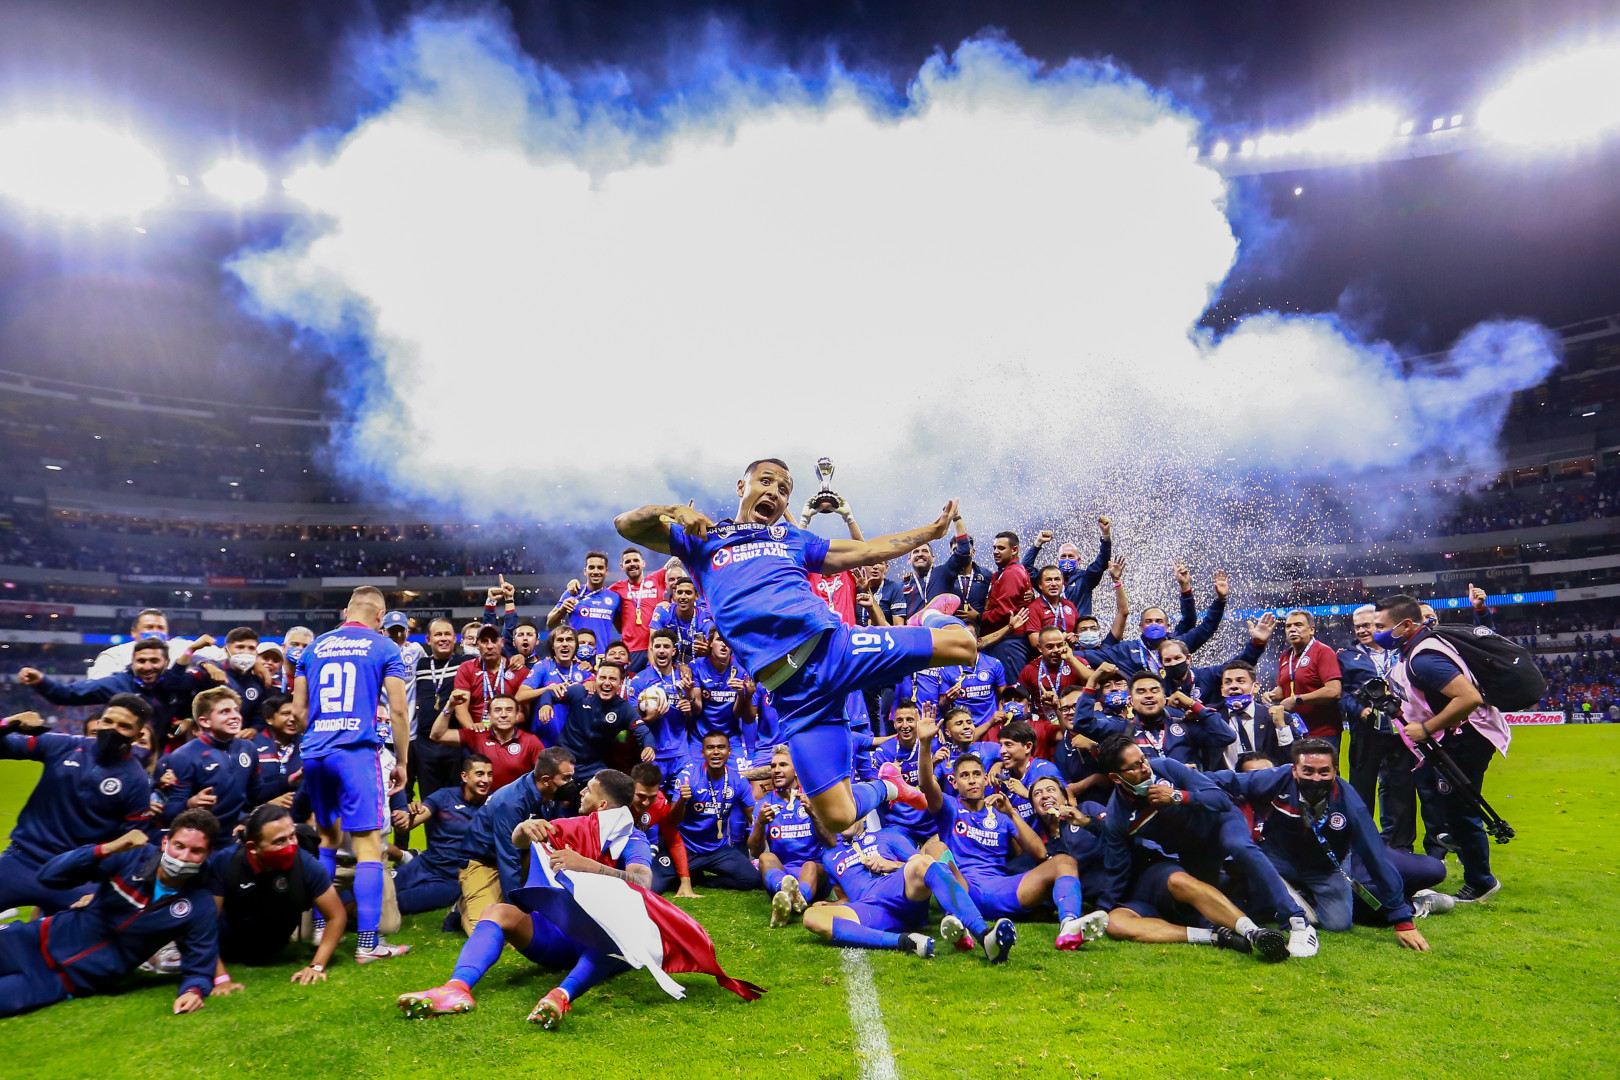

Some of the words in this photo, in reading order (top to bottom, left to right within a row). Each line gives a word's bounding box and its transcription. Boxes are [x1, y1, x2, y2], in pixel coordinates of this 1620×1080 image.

[732, 550, 761, 562] CRUZ
[763, 548, 789, 559] AZUL
[1441, 572, 1477, 581] Corona
[1485, 567, 1523, 578] Corona
[314, 635, 373, 655] Caliente
[852, 633, 881, 655] 19
[317, 650, 368, 658] caliente.mx
[320, 662, 357, 713] 21
[966, 684, 990, 692] CEMENTO
[1504, 713, 1562, 724] AutoZone
[781, 823, 811, 831] CEMENTO
[968, 825, 1000, 840] CEMENTO
[781, 831, 797, 839] CRUZ
[967, 831, 982, 844] CRUZ
[982, 836, 999, 847] AZUL
